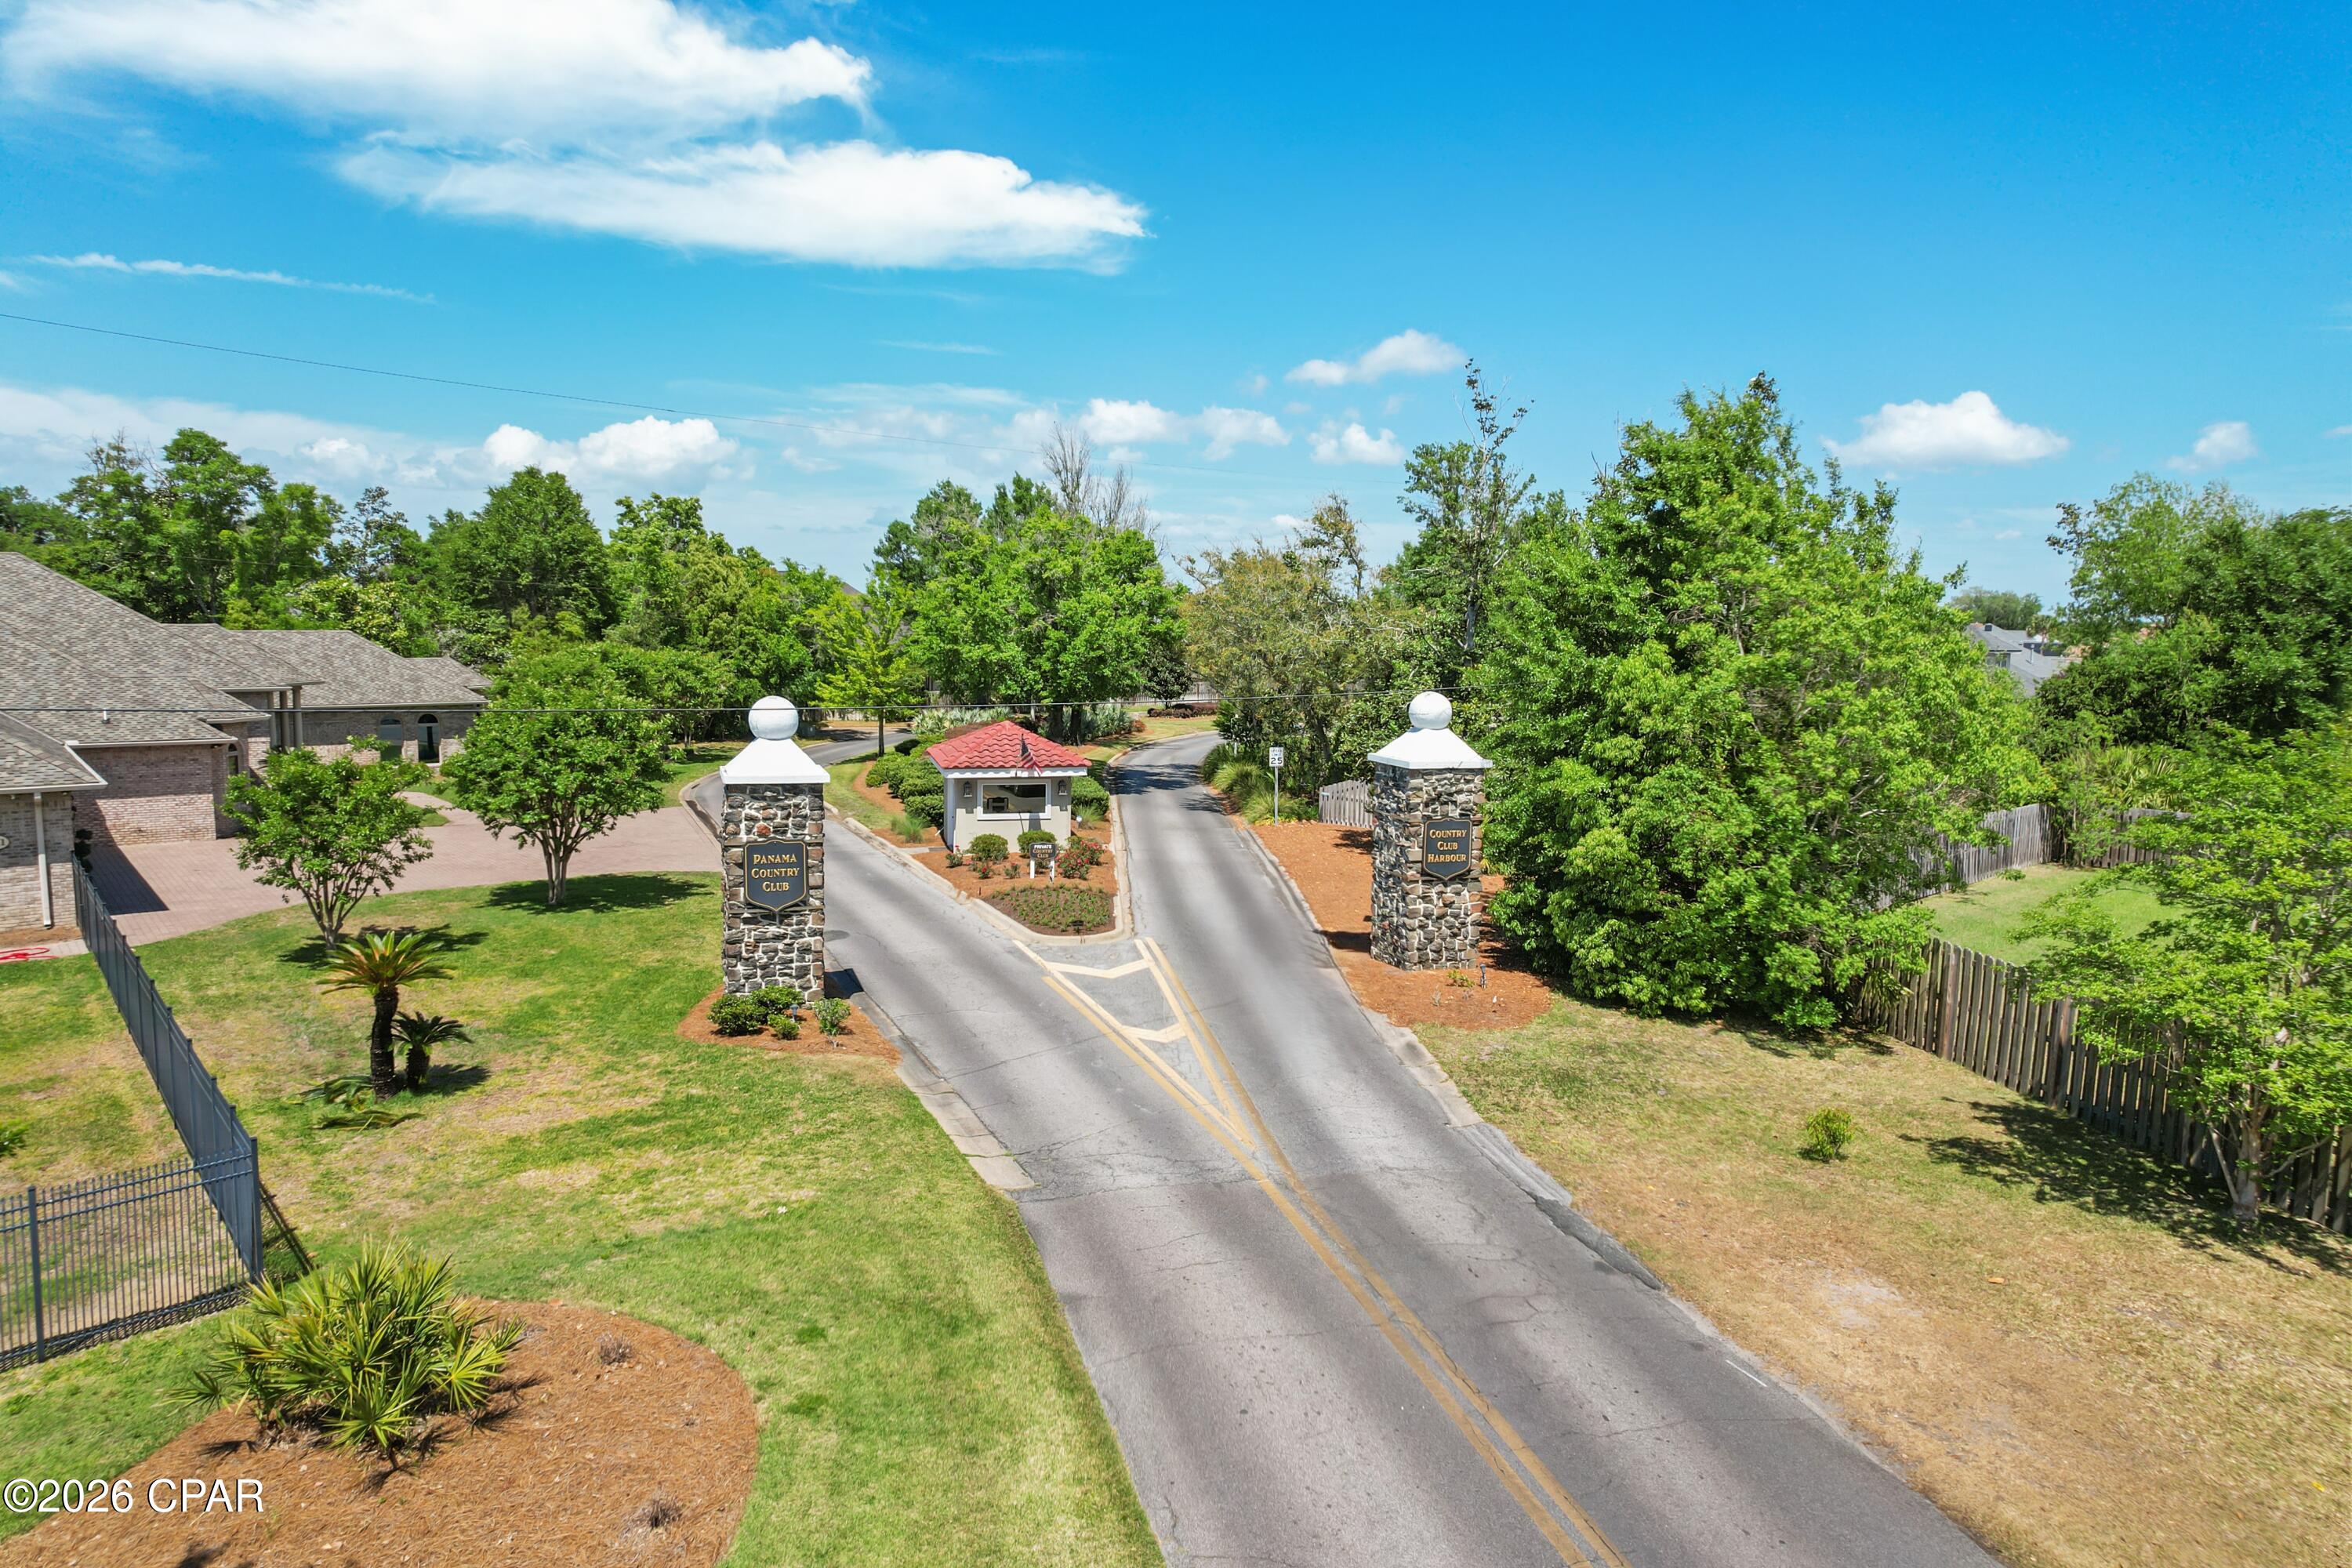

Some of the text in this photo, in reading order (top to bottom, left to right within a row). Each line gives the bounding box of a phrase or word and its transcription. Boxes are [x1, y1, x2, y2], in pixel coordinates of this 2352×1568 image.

[1429, 829, 1467, 838] COUNTRY
[1437, 841, 1458, 851] CLUB
[753, 854, 797, 865] PANAMA
[1428, 853, 1467, 862] HARBOUR
[751, 868, 800, 878] COUNTRY
[762, 881, 789, 892] CLUB
